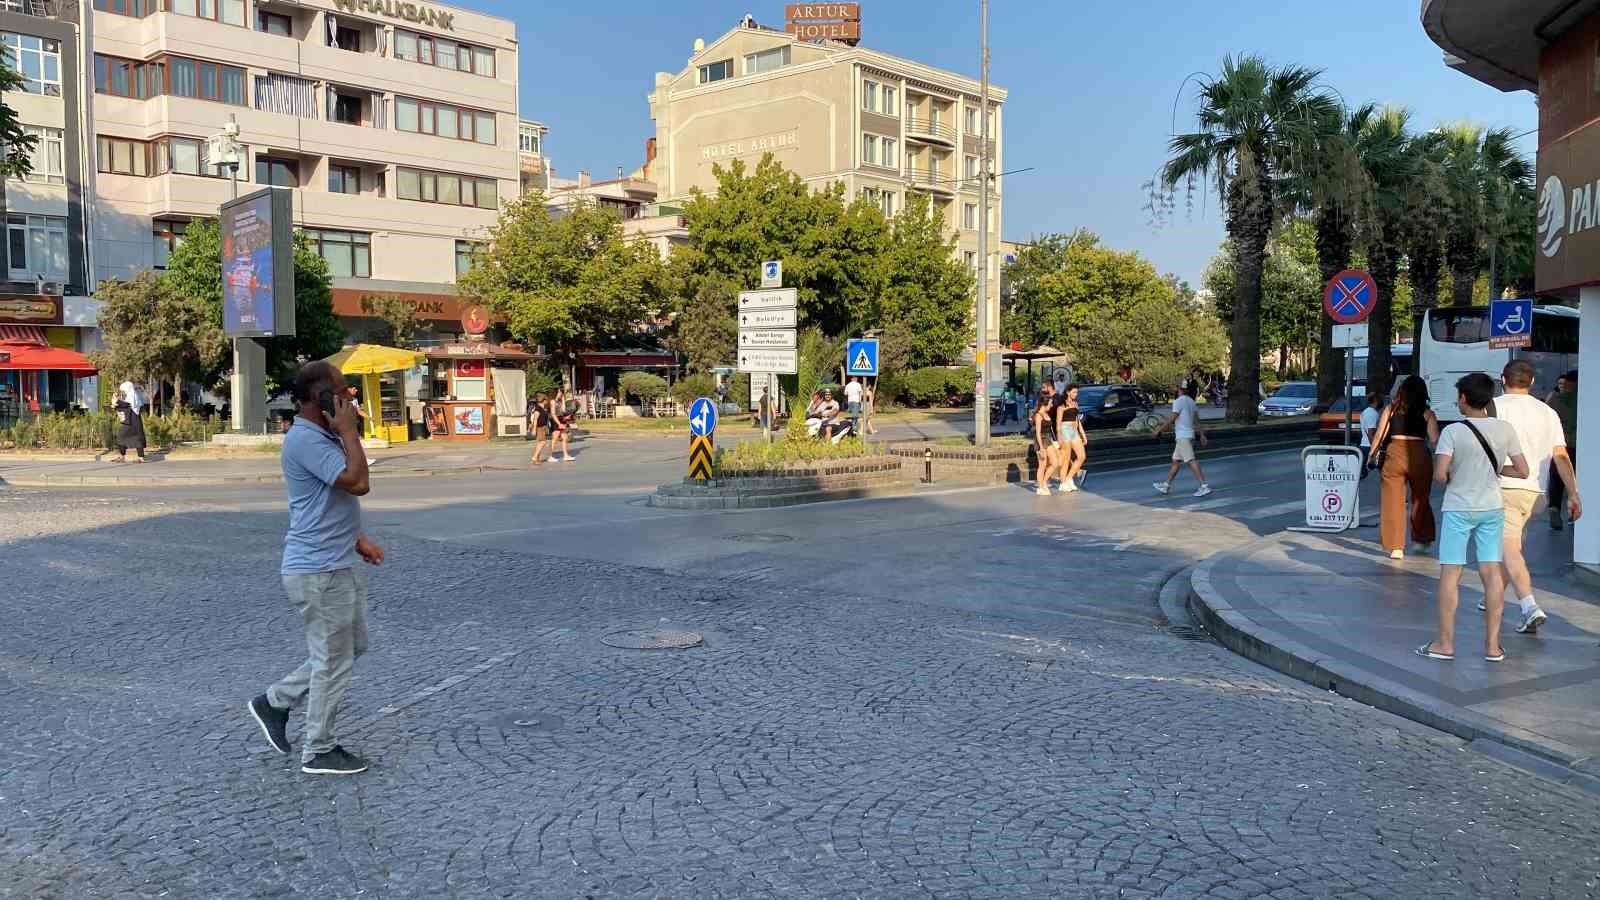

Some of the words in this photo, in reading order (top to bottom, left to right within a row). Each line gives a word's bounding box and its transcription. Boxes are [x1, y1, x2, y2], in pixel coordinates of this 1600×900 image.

[359, 0, 454, 31] HALKBANK
[792, 6, 850, 18] ARTUR
[794, 24, 849, 39] HOTEL
[702, 143, 744, 160] HOTEL
[1307, 472, 1328, 481] KULE
[1329, 472, 1357, 482] HOTEL
